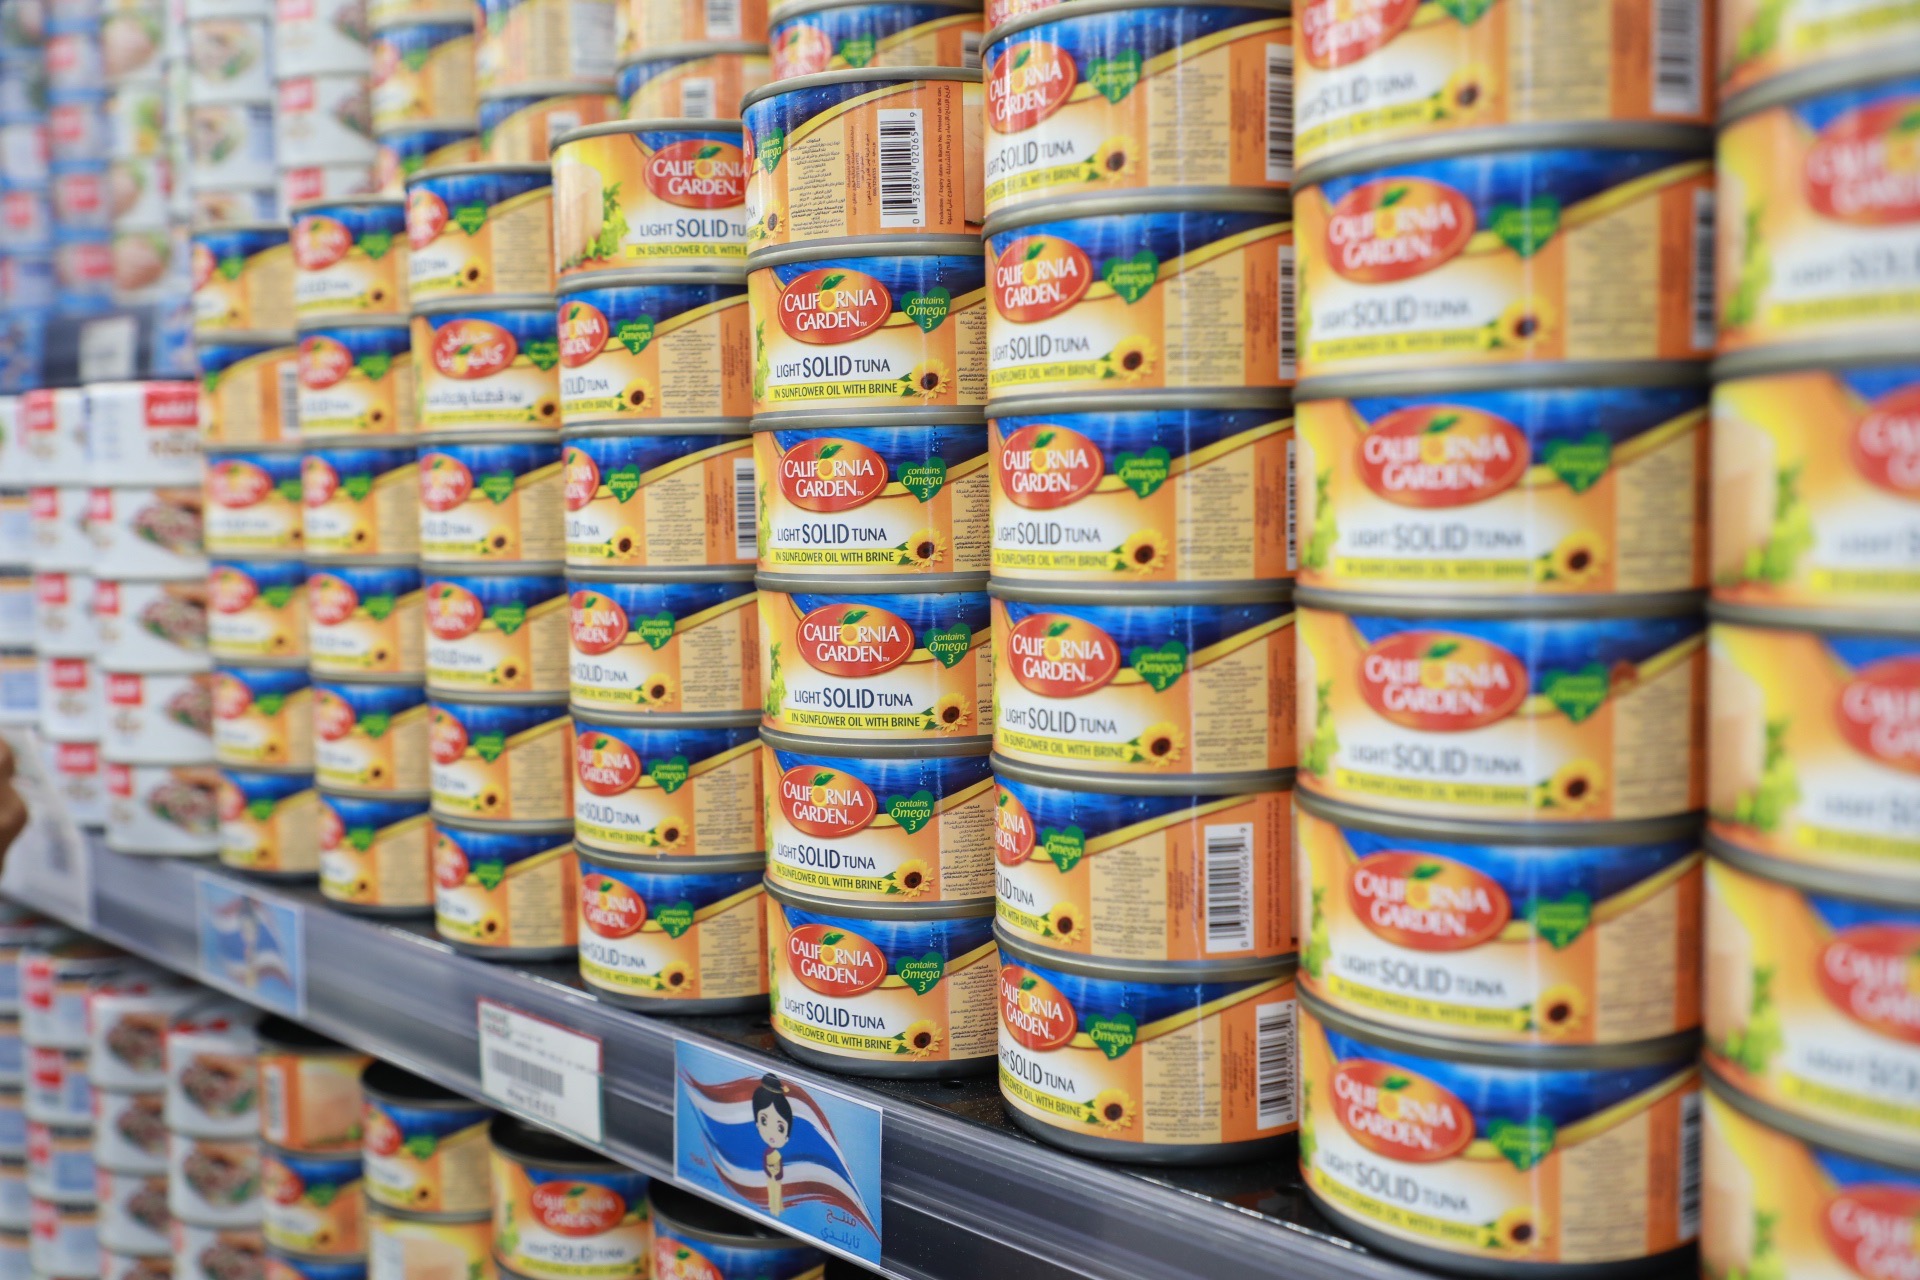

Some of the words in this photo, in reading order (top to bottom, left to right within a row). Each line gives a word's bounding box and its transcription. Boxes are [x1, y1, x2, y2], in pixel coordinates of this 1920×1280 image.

[911, 131, 919, 163] 02065
[1000, 141, 1038, 172] SOLID
[768, 160, 774, 170] 3
[668, 178, 736, 195] GARDEN
[911, 170, 920, 203] 32894
[640, 224, 672, 237] LIGHT
[676, 219, 728, 237] SOLID
[648, 245, 700, 255] SUNFLOWER
[703, 246, 717, 254] OIL
[719, 245, 741, 254] WITH
[997, 257, 1078, 288] CALIFORNIA
[784, 288, 877, 312] CALIFORNIA
[911, 295, 944, 305] contains
[1005, 282, 1060, 310] GARDEN
[796, 310, 860, 331] GARDEN
[907, 305, 946, 317] Omega
[925, 318, 932, 328] 3
[619, 331, 650, 341] Omega
[1009, 334, 1052, 360] SOLID
[1054, 337, 1089, 352] TUNA
[776, 363, 801, 378] LIGHT
[803, 356, 852, 378] SOLID
[854, 359, 890, 372] TUNA
[774, 389, 780, 398] IN
[782, 386, 824, 398] SUNFLOWER
[827, 386, 840, 395] OIL
[843, 385, 866, 395] WITH
[869, 383, 897, 393] BRINE
[784, 459, 874, 480] CALIFORNIA
[907, 465, 940, 475] contains
[1003, 449, 1088, 472] CALIFORNIA
[796, 480, 857, 498] GARDEN
[903, 474, 943, 486] Omega
[1012, 471, 1070, 493] GARDEN
[921, 488, 928, 498] 3
[777, 529, 800, 541] LIGHT
[802, 524, 849, 544] SOLID
[852, 528, 887, 541] TUNA
[1018, 522, 1061, 544] SOLID
[1064, 528, 1101, 542] TUNA
[775, 552, 781, 560] IN
[782, 552, 823, 562] SUNFLOWER
[825, 553, 838, 562] OIL
[841, 553, 864, 562] WITH
[866, 552, 894, 561] BRINE
[638, 626, 672, 637] Omega
[804, 623, 900, 645] CALIFORNIA
[934, 633, 965, 641] contains
[817, 643, 882, 662] GARDEN
[929, 641, 967, 653] Omega
[1012, 634, 1105, 661] CALIFORNIA
[947, 654, 954, 664] 3
[1135, 662, 1183, 675] Omega
[1023, 658, 1086, 682] GARDEN
[795, 690, 821, 704] LIGHT
[823, 688, 875, 708] SOLID
[877, 693, 913, 706] TUNA
[792, 713, 798, 722] IN
[800, 714, 845, 726] SUNFLOWER
[849, 717, 863, 727] OIL
[865, 717, 888, 727] WITH
[891, 717, 920, 726] BRINE
[1005, 709, 1026, 725] LIGHT
[1028, 708, 1076, 733] SOLID
[1079, 719, 1117, 734] TUNA
[1067, 745, 1090, 756] WITH
[652, 770, 686, 782] Omega
[784, 781, 864, 807] CALIFORNIA
[616, 814, 640, 825] TUNA
[793, 803, 848, 825] GARDEN
[891, 807, 930, 820] Omega
[909, 820, 916, 831] 3
[778, 843, 797, 861] LIGHT
[798, 844, 840, 869] SOLID
[842, 855, 875, 869] TUNA
[1046, 842, 1081, 860] Omega
[1061, 859, 1069, 870] 3
[776, 866, 781, 875] IN
[782, 868, 816, 884] SUNFLOWER
[818, 876, 830, 886] OIL
[832, 878, 853, 888] WITH
[855, 880, 882, 890] BRINE
[1012, 886, 1034, 907] TUNA
[791, 938, 874, 967] CALIFORNIA
[801, 959, 857, 985] GARDEN
[901, 969, 940, 981] Omega
[906, 961, 938, 969] contains
[919, 982, 926, 992] 3
[1000, 977, 1064, 1023] CALIFORNIA
[784, 998, 805, 1016] LIGHT
[806, 1001, 849, 1027] SOLID
[852, 1015, 885, 1030] TUNA
[1006, 1003, 1050, 1040] GARDEN
[782, 1018, 788, 1028] IN
[788, 1021, 824, 1041] SUNFLOWER
[826, 1033, 839, 1044] OIL
[841, 1036, 863, 1047] WITH
[865, 1038, 891, 1050] BRINE
[1090, 1030, 1133, 1045] Omega
[1109, 1045, 1118, 1057] 3
[1009, 1050, 1042, 1084] SOLID
[1044, 1072, 1075, 1093] TUNA
[1024, 1089, 1034, 1102] OIL
[1035, 1094, 1054, 1109] WITH
[1056, 1101, 1082, 1117] BRINE
[826, 1207, 857, 1228] منتج
[820, 1226, 861, 1249] تايلندي
